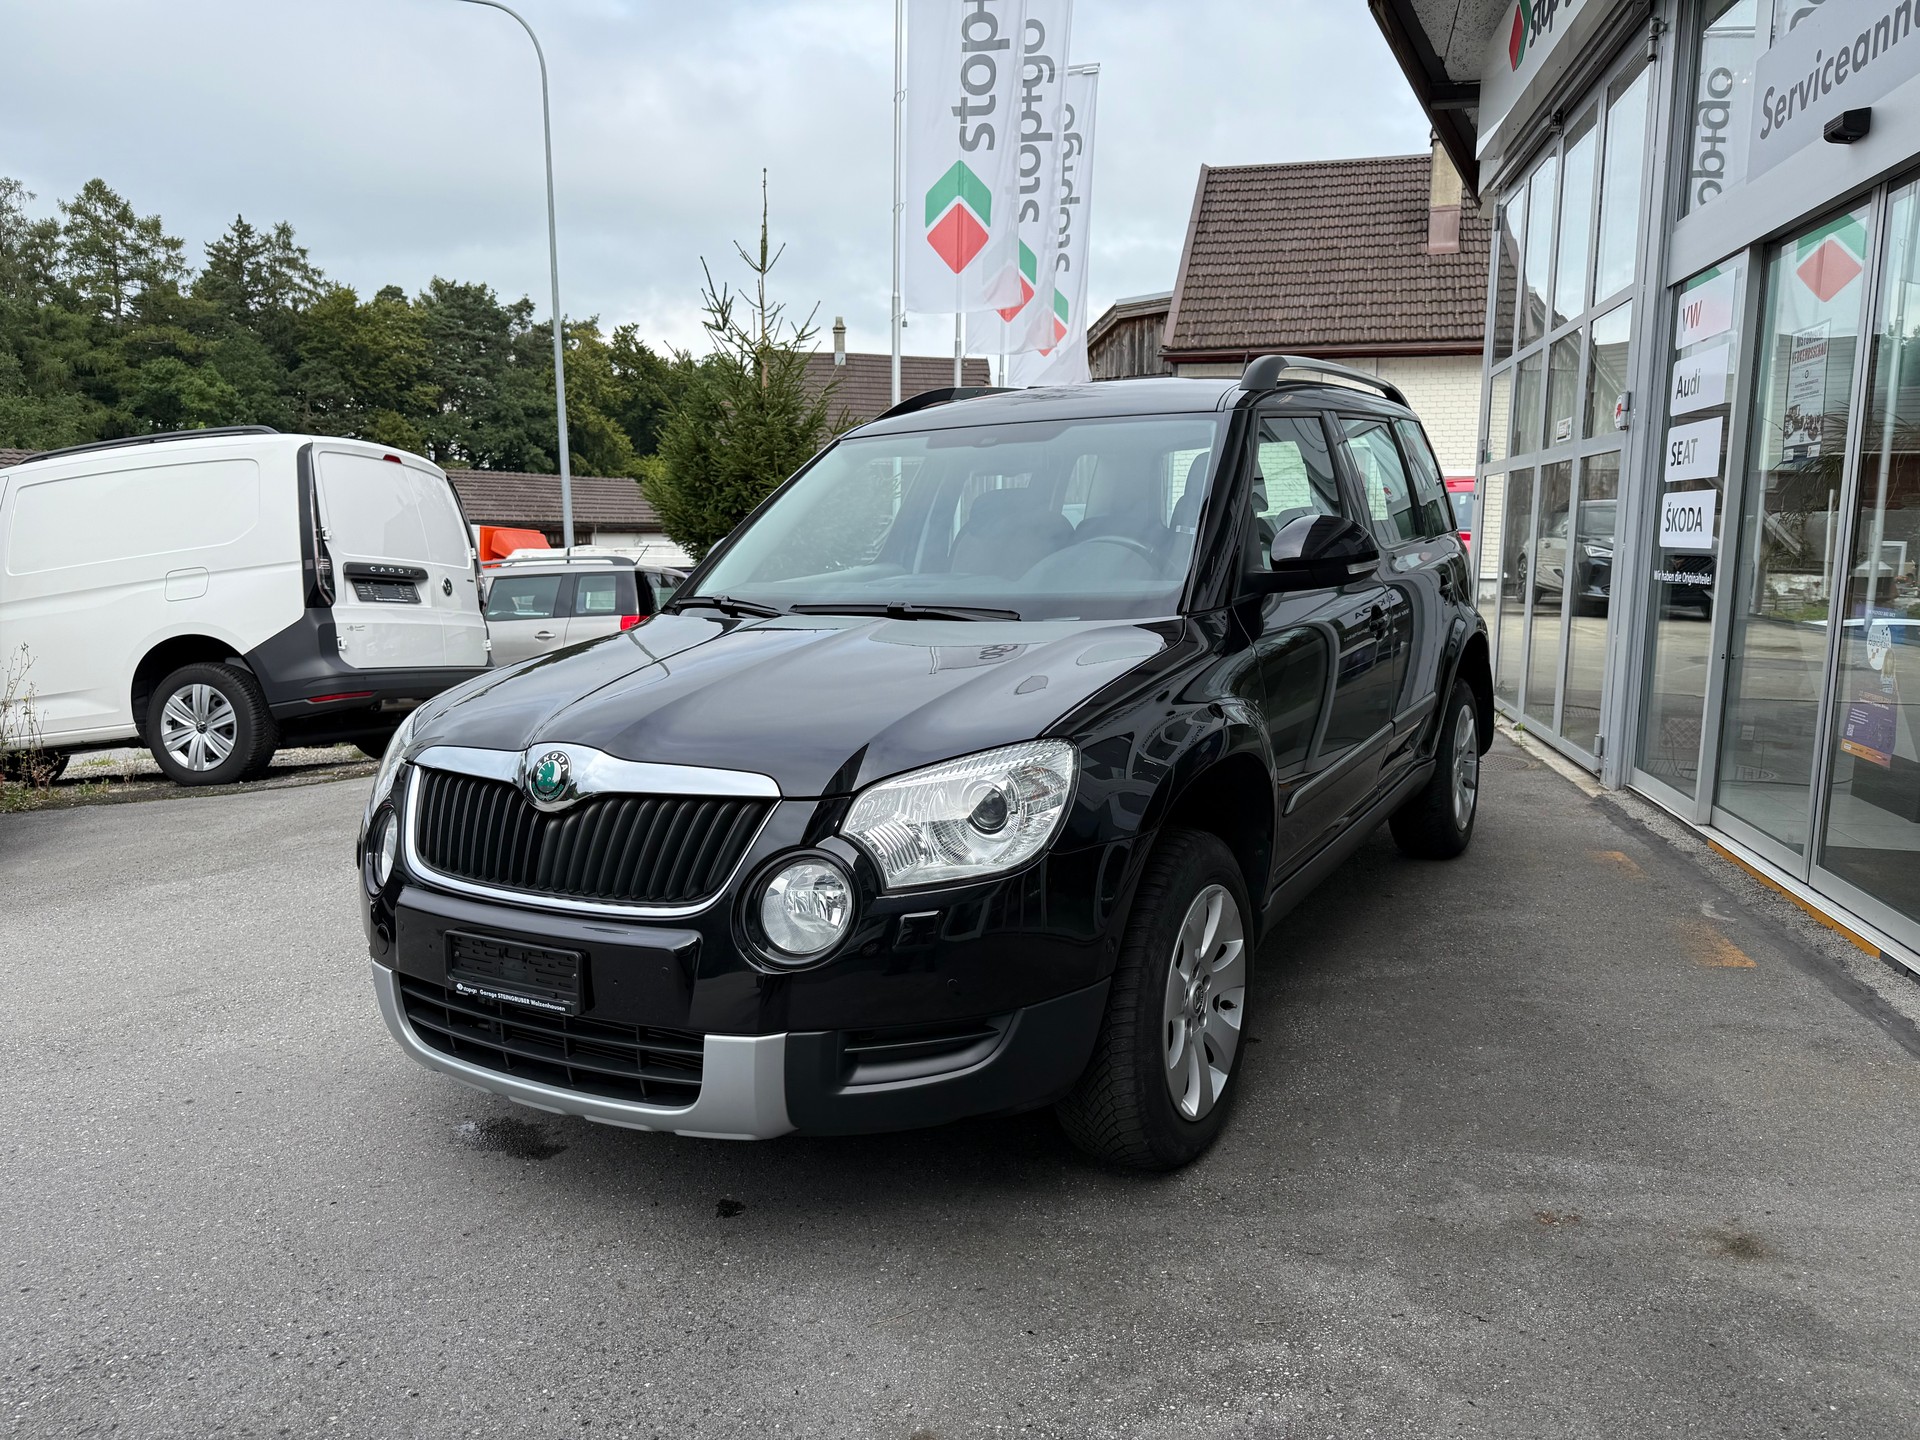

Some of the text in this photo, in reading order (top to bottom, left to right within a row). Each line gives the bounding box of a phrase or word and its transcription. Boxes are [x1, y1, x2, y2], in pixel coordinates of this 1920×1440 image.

[1683, 300, 1703, 332] VW
[1676, 368, 1701, 400] Audi
[1671, 438, 1698, 467] SEAT
[1665, 502, 1703, 532] ŠKODA
[370, 566, 411, 575] CADDY
[1662, 570, 1674, 582] haben
